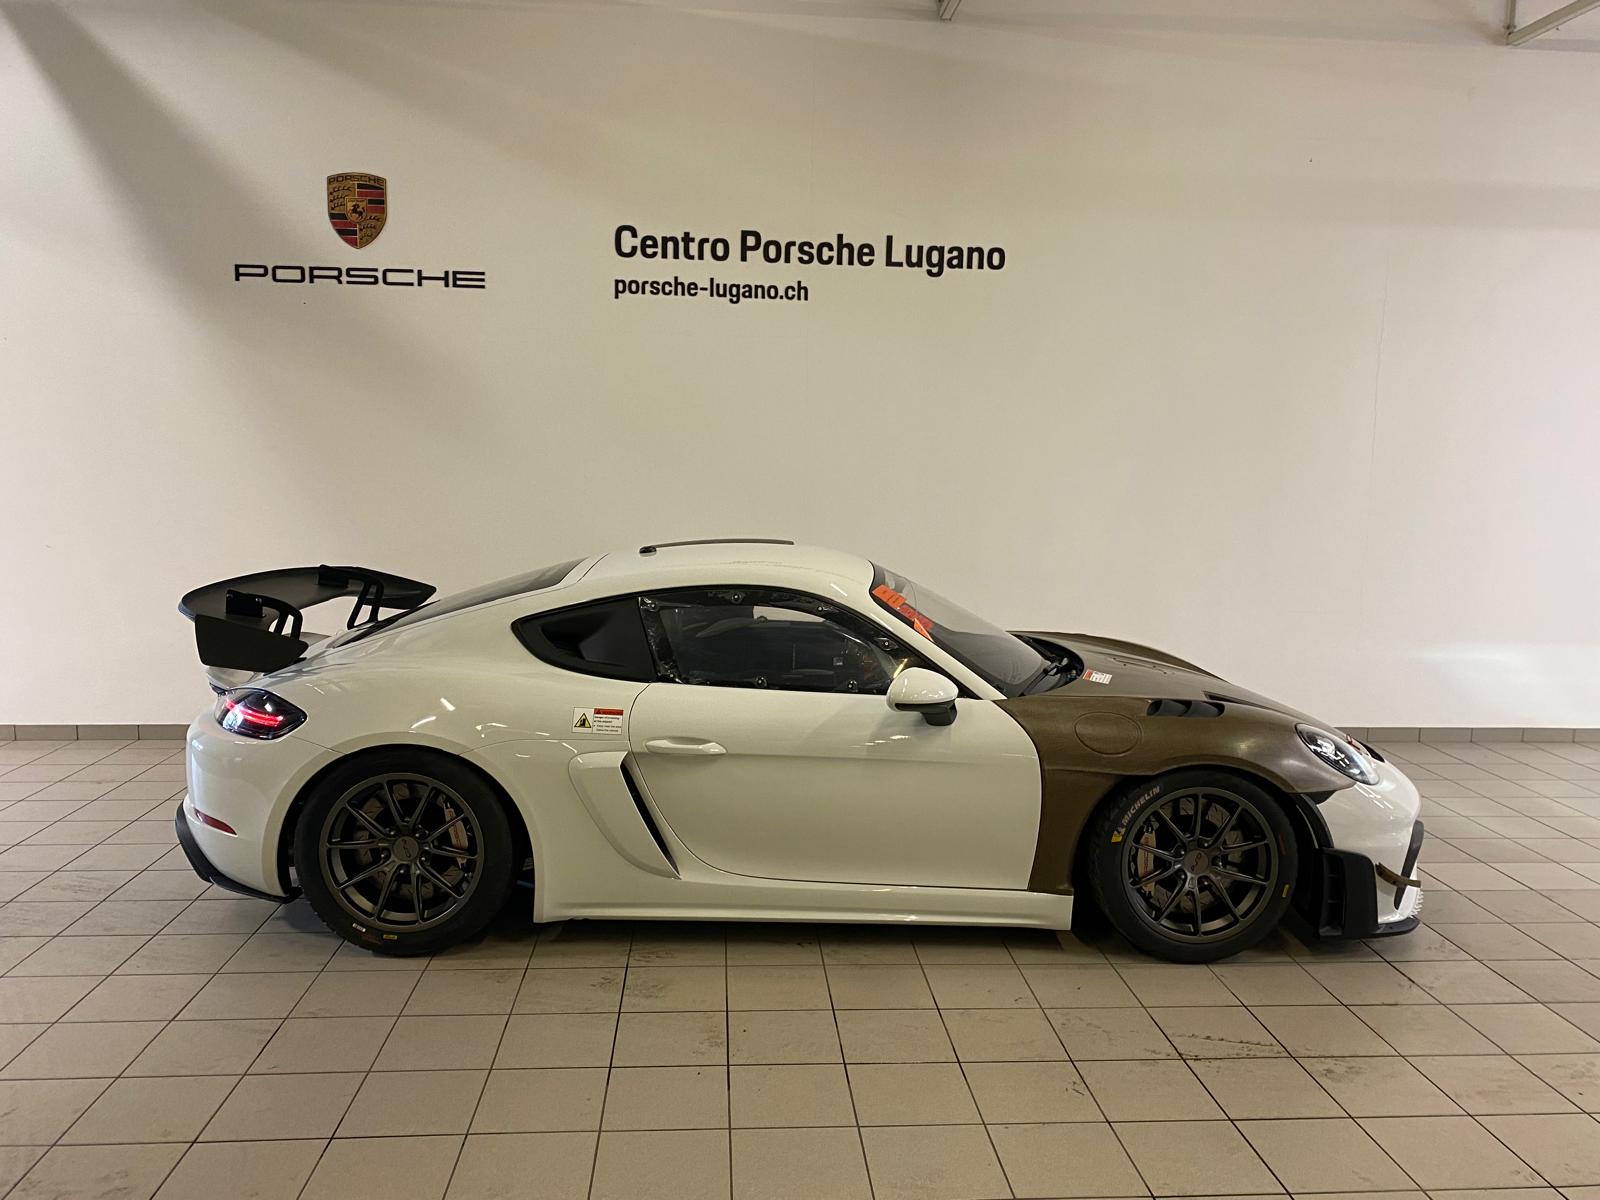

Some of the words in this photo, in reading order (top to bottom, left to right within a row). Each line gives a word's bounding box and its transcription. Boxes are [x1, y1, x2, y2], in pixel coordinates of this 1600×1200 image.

[328, 174, 385, 186] PORSCHE
[614, 224, 730, 262] Centro
[740, 229, 876, 267] Porsche
[885, 234, 1006, 278] Lugano
[233, 263, 486, 289] PORSCHE
[614, 275, 809, 304] porsche-lugano.ch
[1121, 785, 1161, 826] MICHELIN
